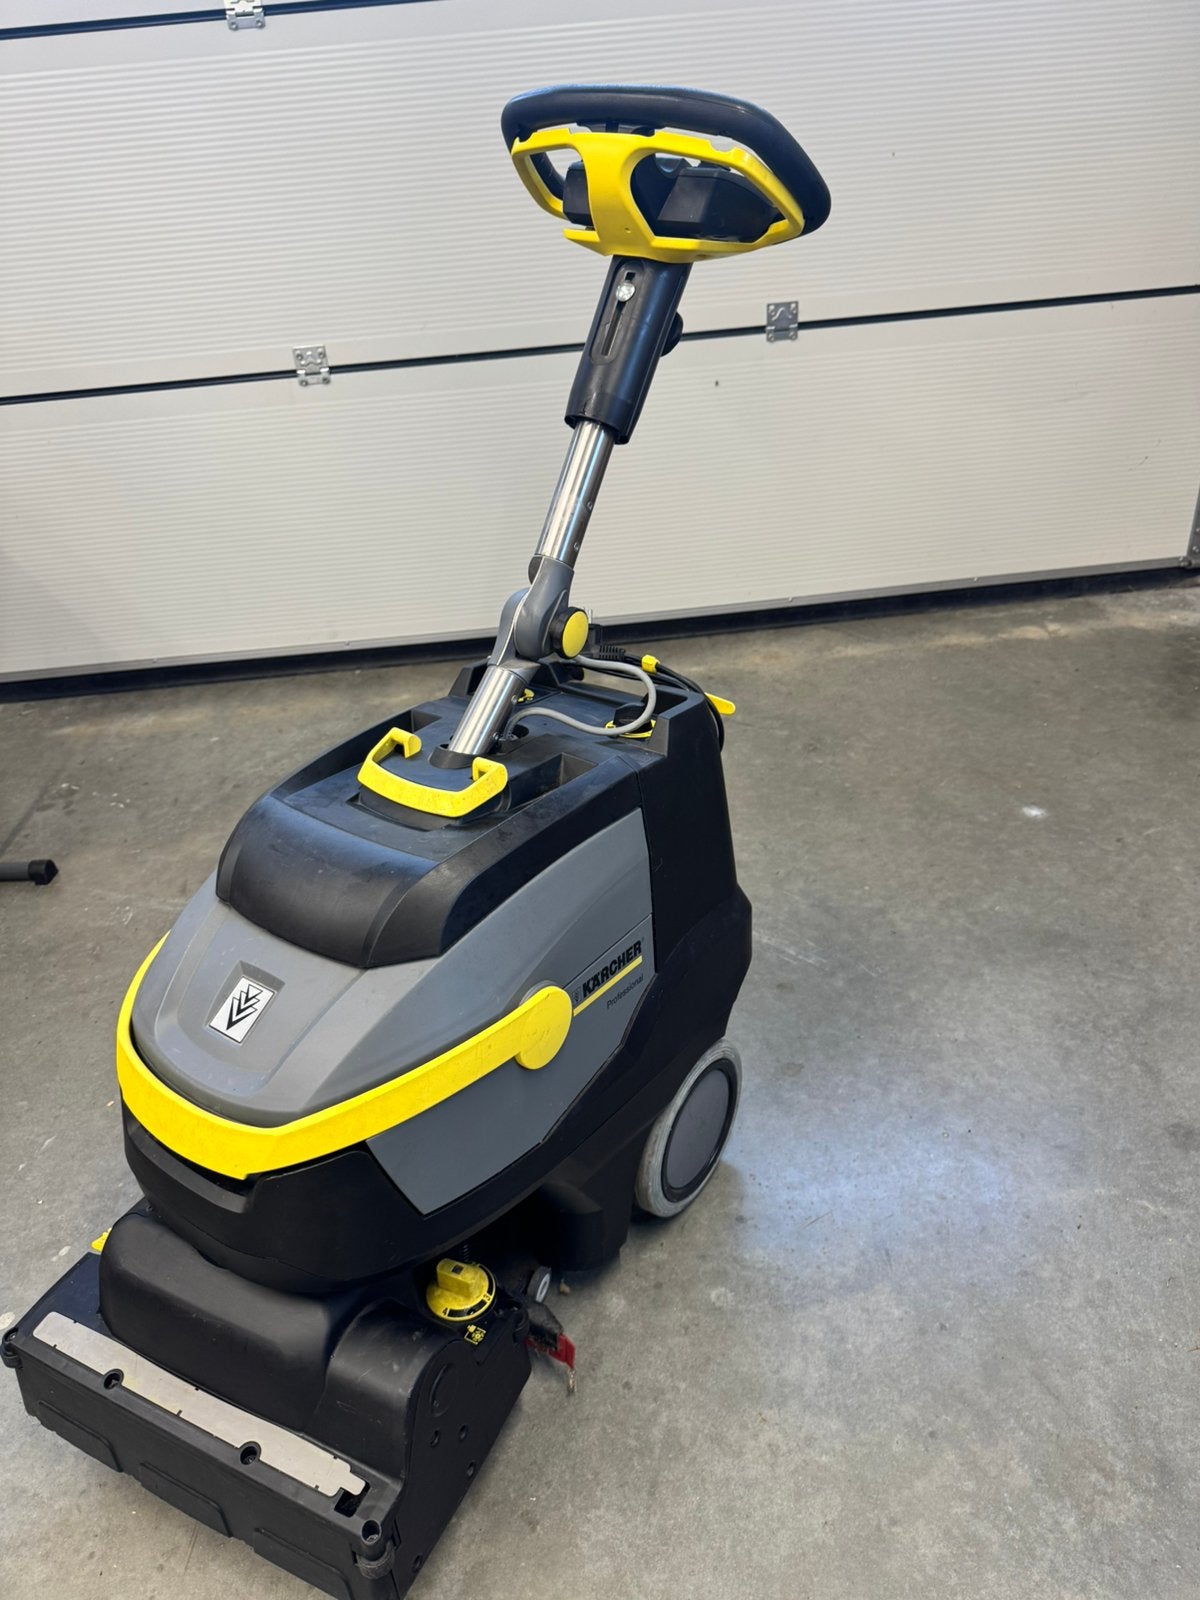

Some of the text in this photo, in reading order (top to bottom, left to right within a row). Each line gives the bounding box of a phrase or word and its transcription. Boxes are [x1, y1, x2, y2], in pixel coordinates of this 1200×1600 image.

[582, 940, 642, 998] KÄRCHER
[606, 973, 644, 1010] Professional
[441, 1307, 448, 1316] 4
